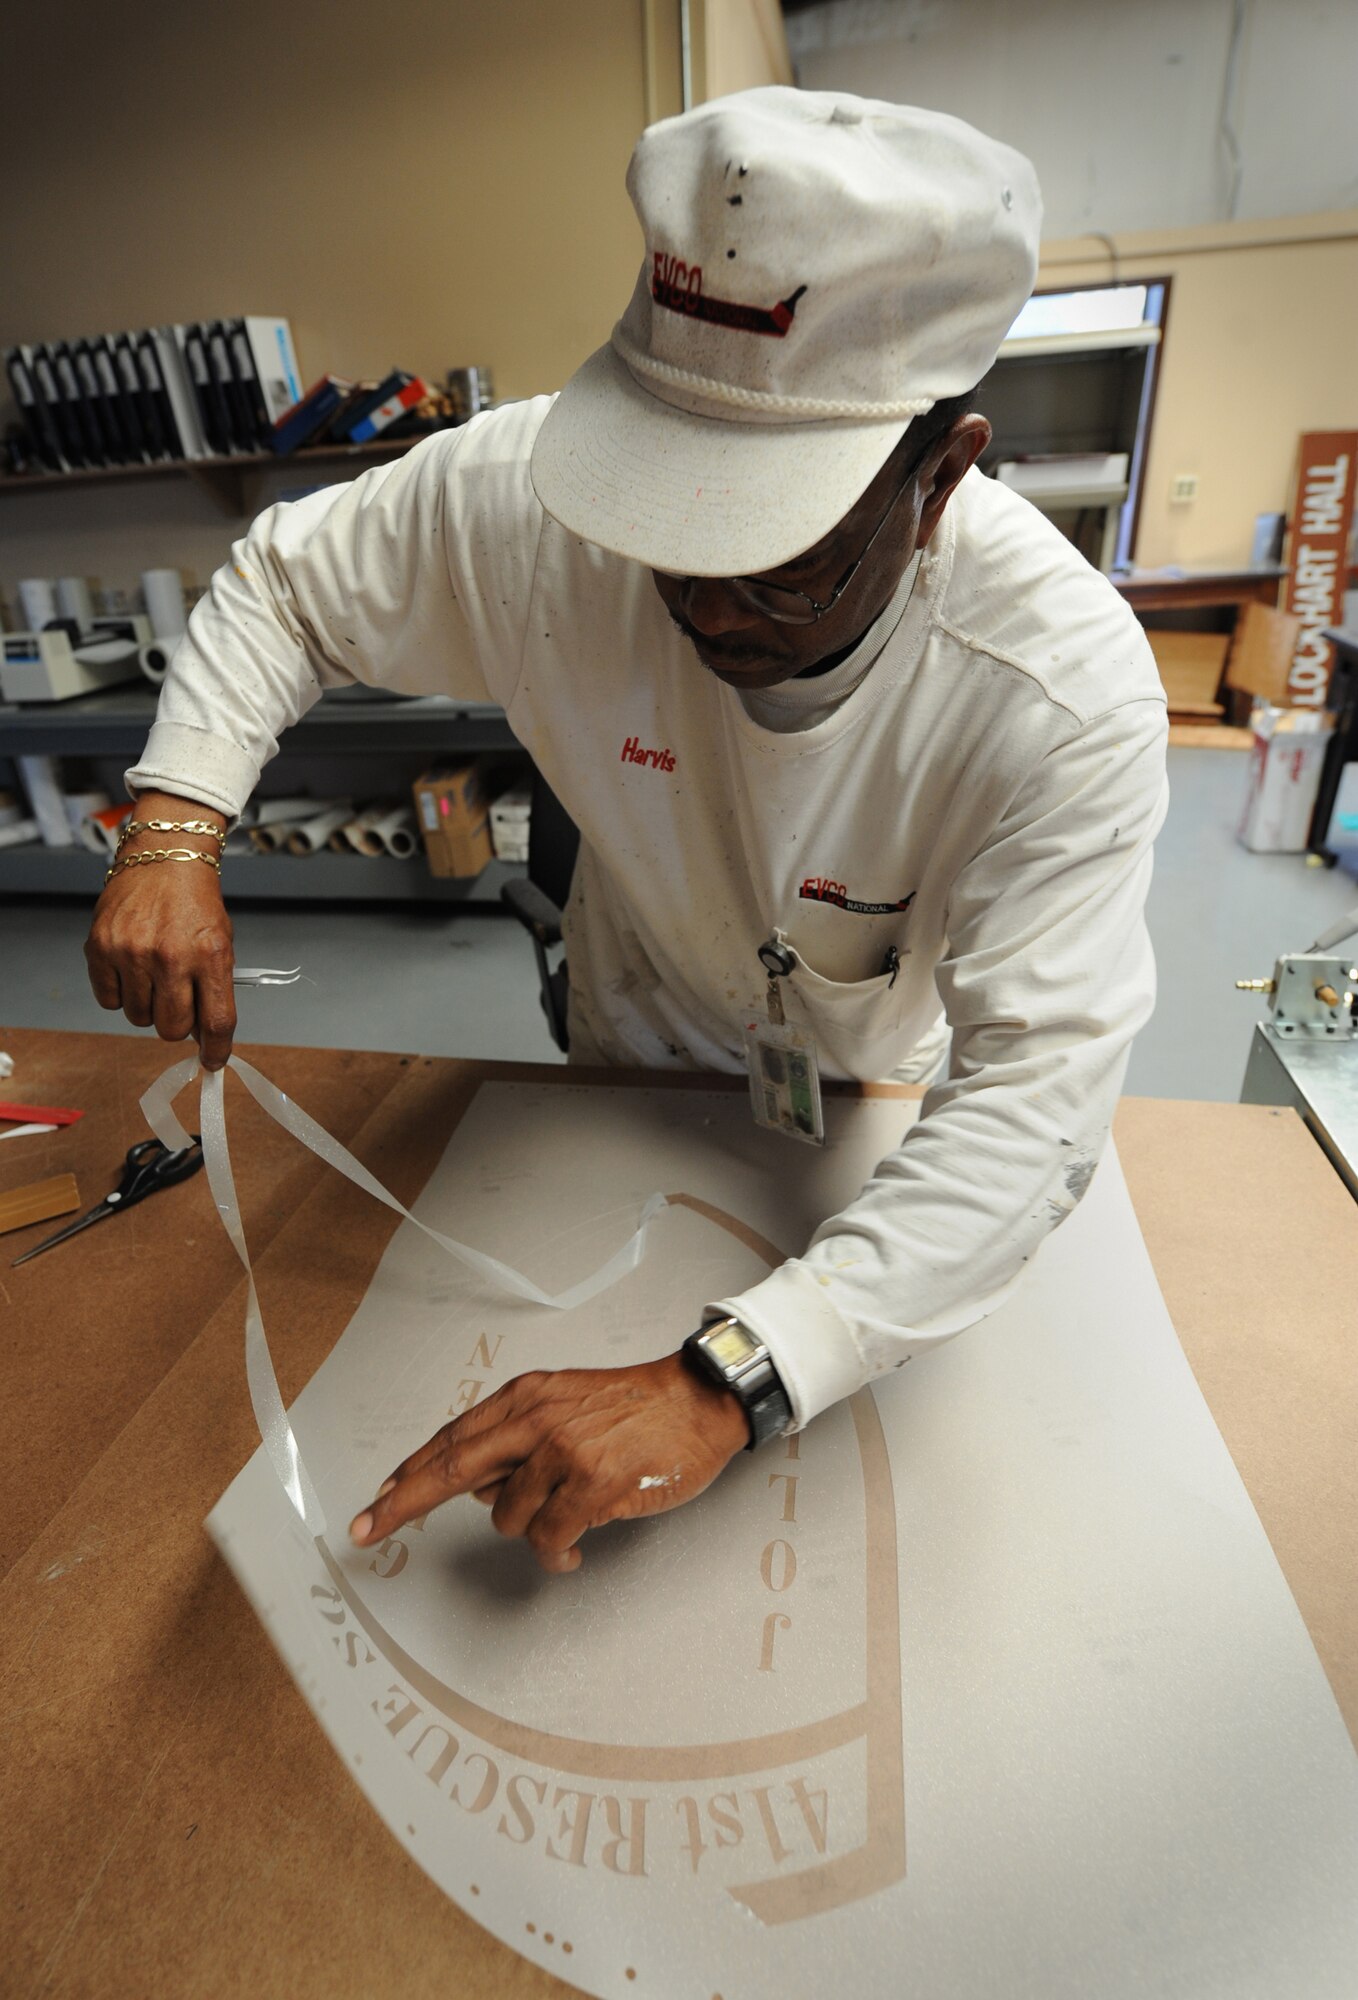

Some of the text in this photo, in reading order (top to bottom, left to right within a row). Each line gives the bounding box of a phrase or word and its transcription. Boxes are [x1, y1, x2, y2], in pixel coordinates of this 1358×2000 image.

[652, 252, 702, 311] EVCO
[1300, 454, 1350, 535] HALL
[621, 736, 676, 773] Harvis
[802, 878, 889, 913] EVCO NATIONAL
[371, 1684, 650, 1878] RESCUE
[676, 1775, 829, 1875] 41st
